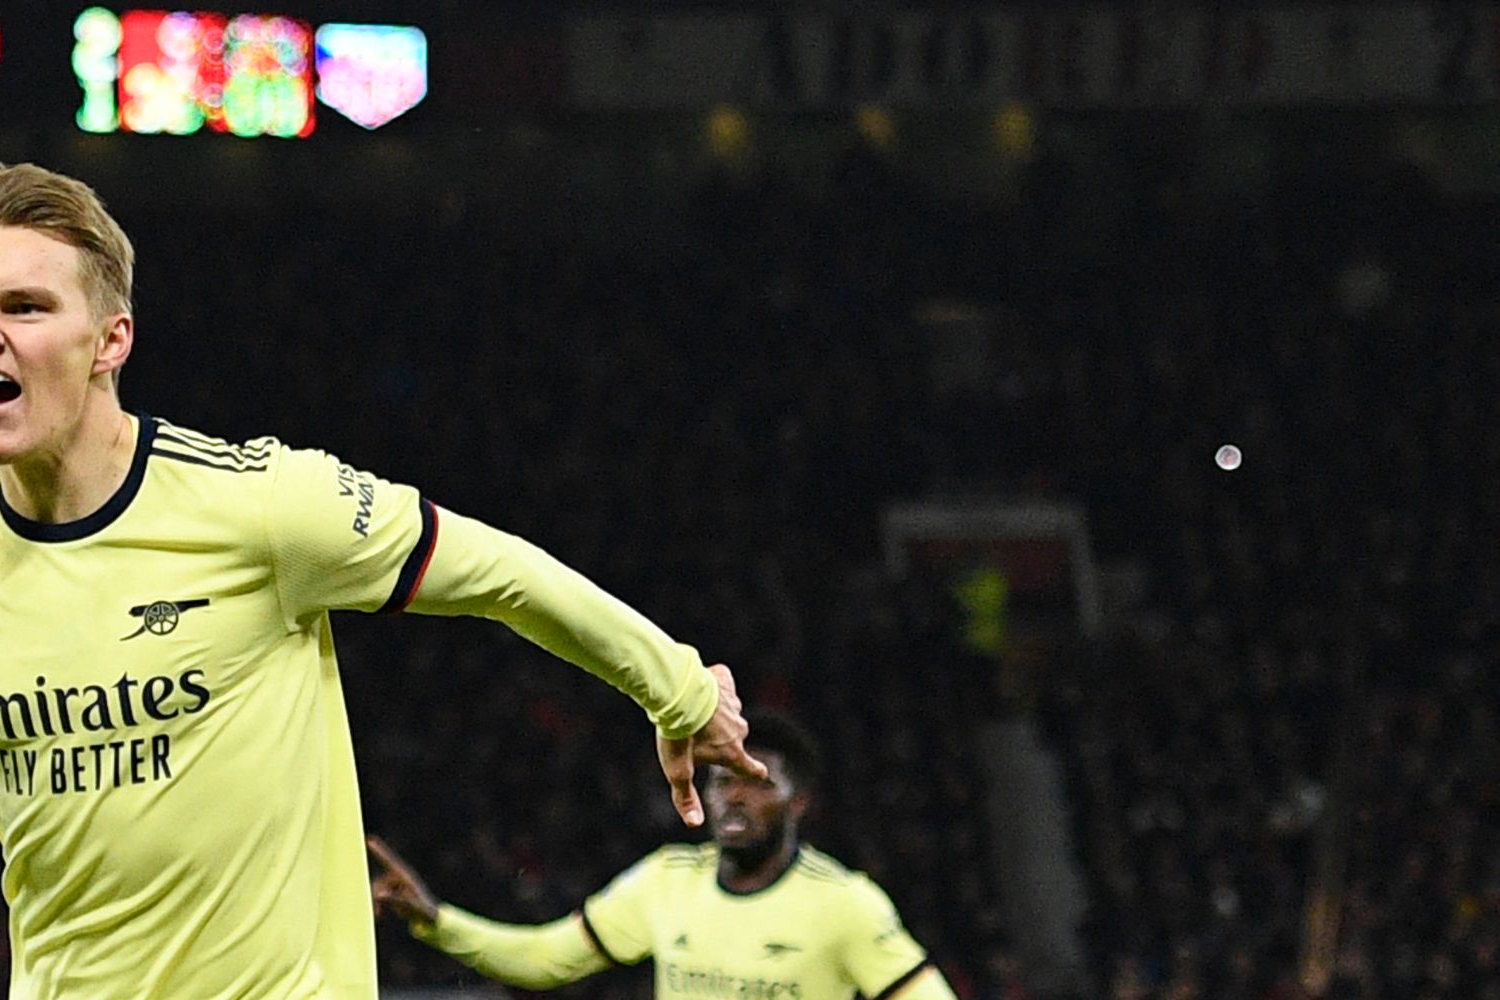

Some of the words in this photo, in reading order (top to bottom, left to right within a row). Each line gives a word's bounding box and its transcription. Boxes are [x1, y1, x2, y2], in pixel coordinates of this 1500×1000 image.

[337, 466, 355, 497] VIS
[0, 749, 37, 796] FLY
[51, 734, 172, 794] BETTER
